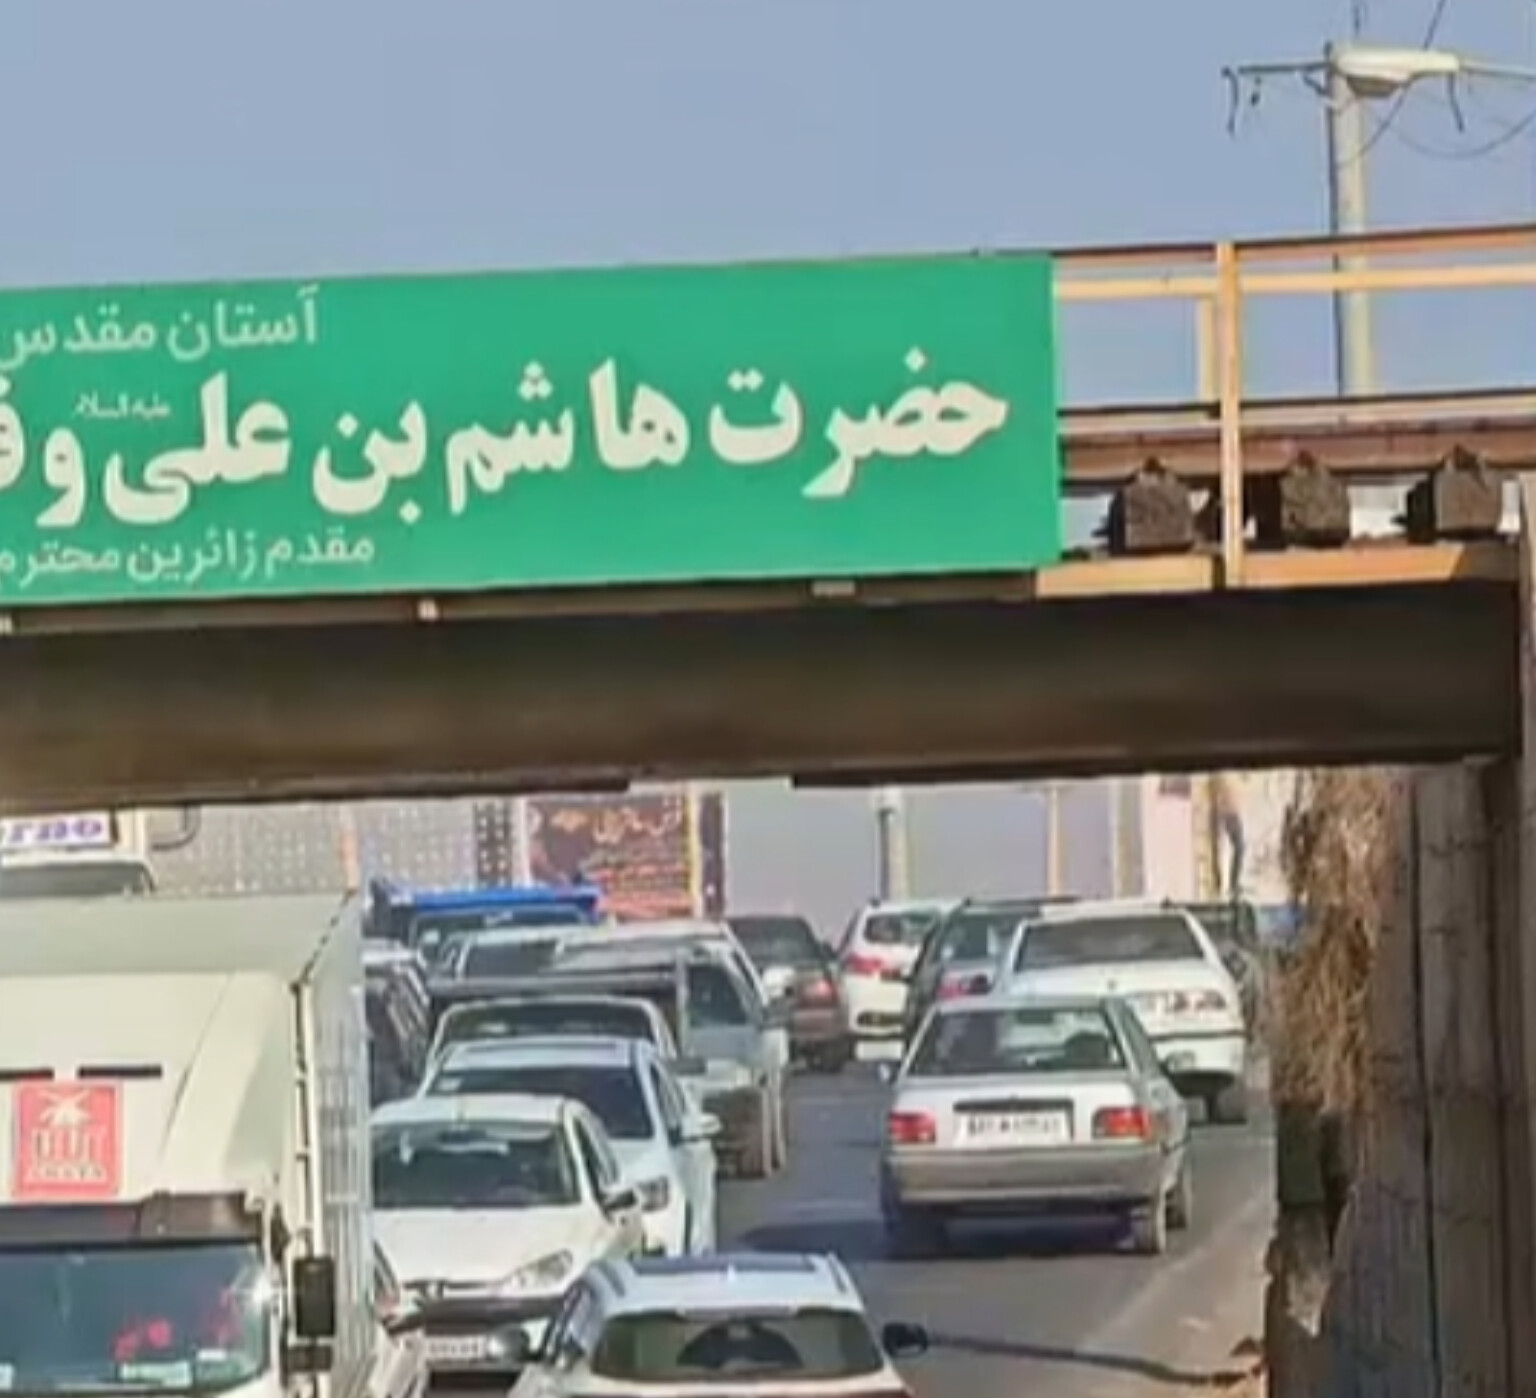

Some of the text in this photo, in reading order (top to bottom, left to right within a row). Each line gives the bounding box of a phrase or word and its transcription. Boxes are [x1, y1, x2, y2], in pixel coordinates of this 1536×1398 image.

[166, 285, 320, 361] آستان
[35, 426, 88, 529] و
[102, 371, 292, 526] علی
[311, 400, 429, 525] بن
[444, 358, 691, 516] هاشم
[707, 346, 1013, 499] حضرت
[125, 528, 256, 584] زائرین
[265, 526, 376, 576] مقدم
